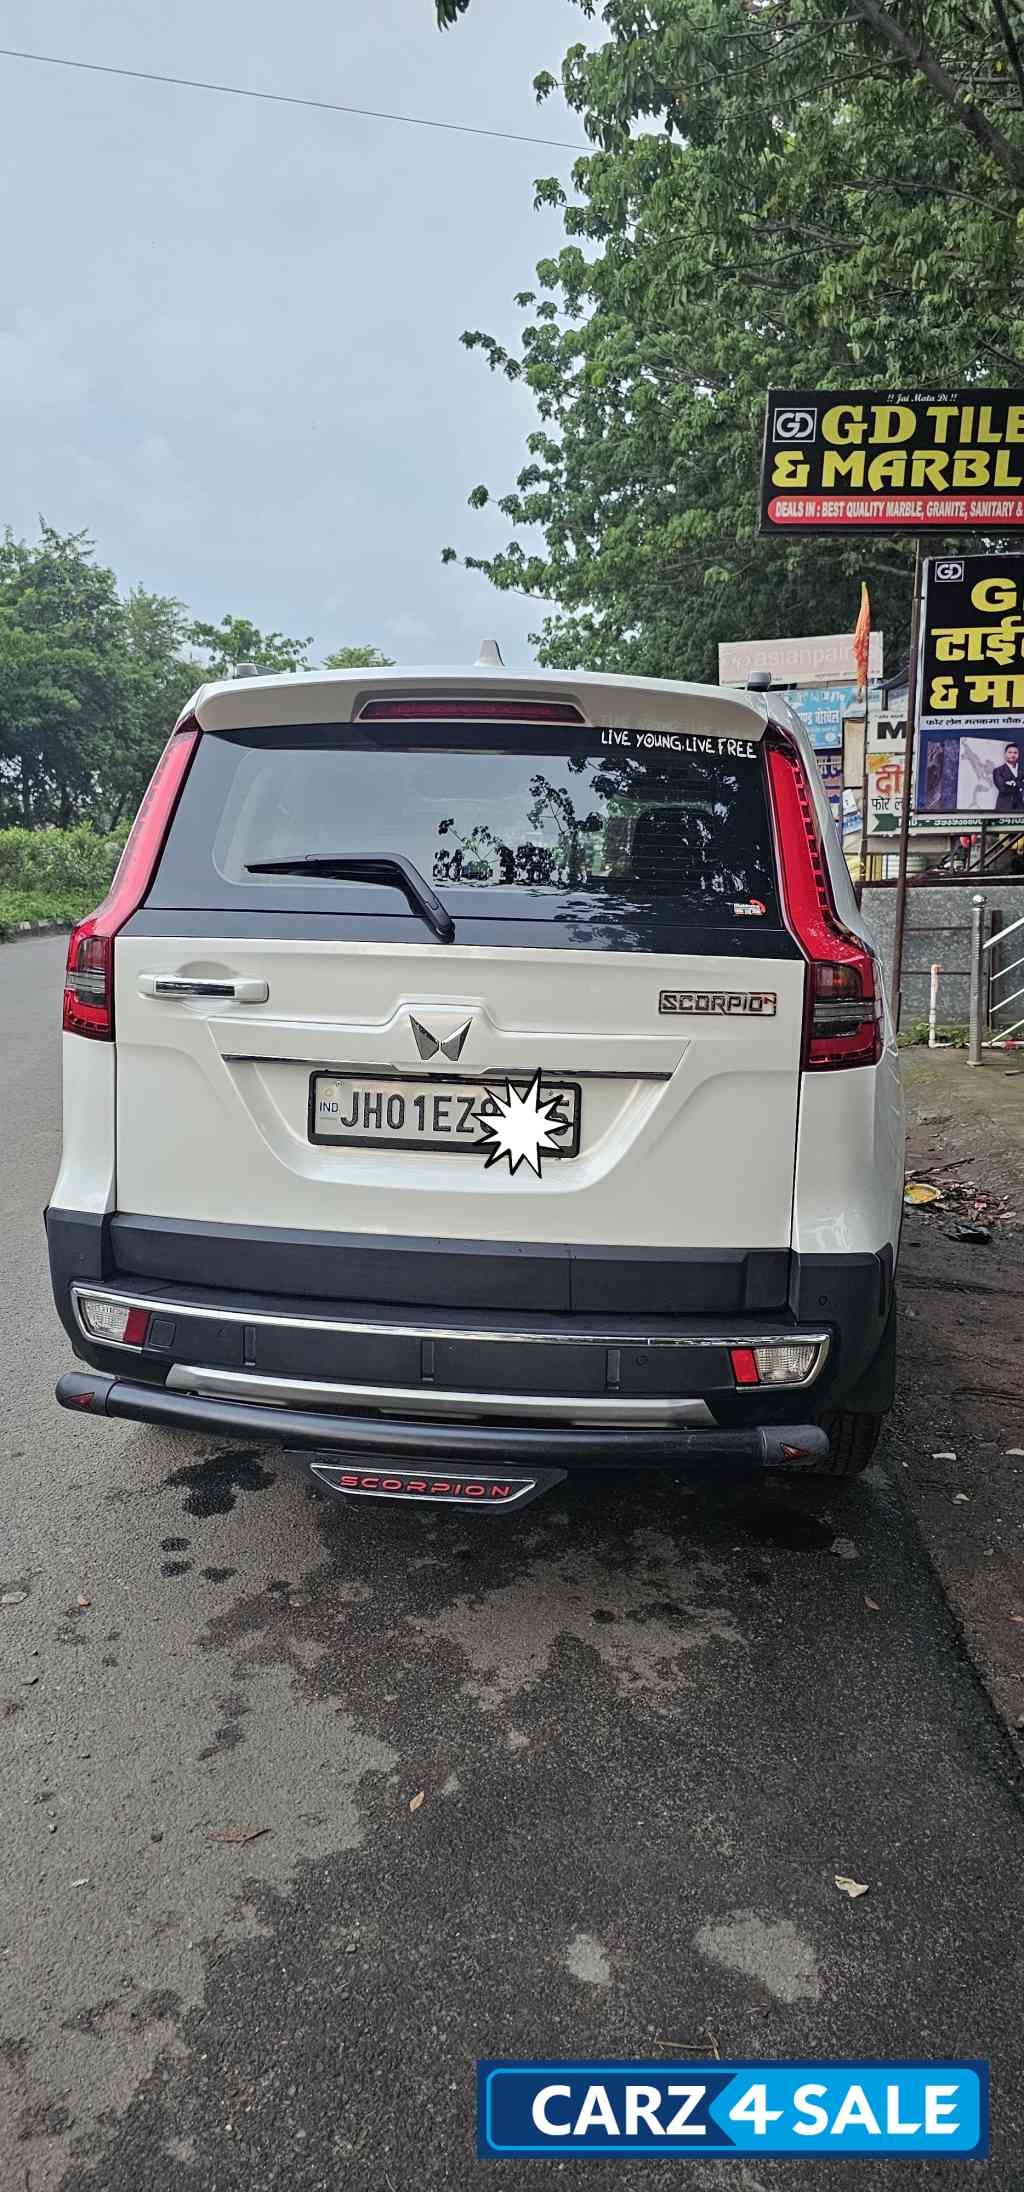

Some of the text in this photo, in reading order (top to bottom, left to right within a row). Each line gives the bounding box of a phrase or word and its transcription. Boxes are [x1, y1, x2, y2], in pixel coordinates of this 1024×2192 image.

[821, 405, 1024, 445] GD TILE
[771, 450, 1024, 492] & MARBL
[775, 501, 804, 518] DEALS
[822, 501, 846, 518] BEST
[846, 501, 886, 518] QUALITY
[886, 501, 924, 521] MARBLE,
[926, 501, 968, 521] GRANITE,
[969, 501, 1015, 517] SANITARY
[970, 577, 1024, 613] G
[931, 615, 1024, 666] टाई
[601, 729, 631, 746] LIVE
[718, 738, 757, 759] FREE
[319, 1102, 339, 1113] IND
[340, 1475, 512, 1497] SCORPION
